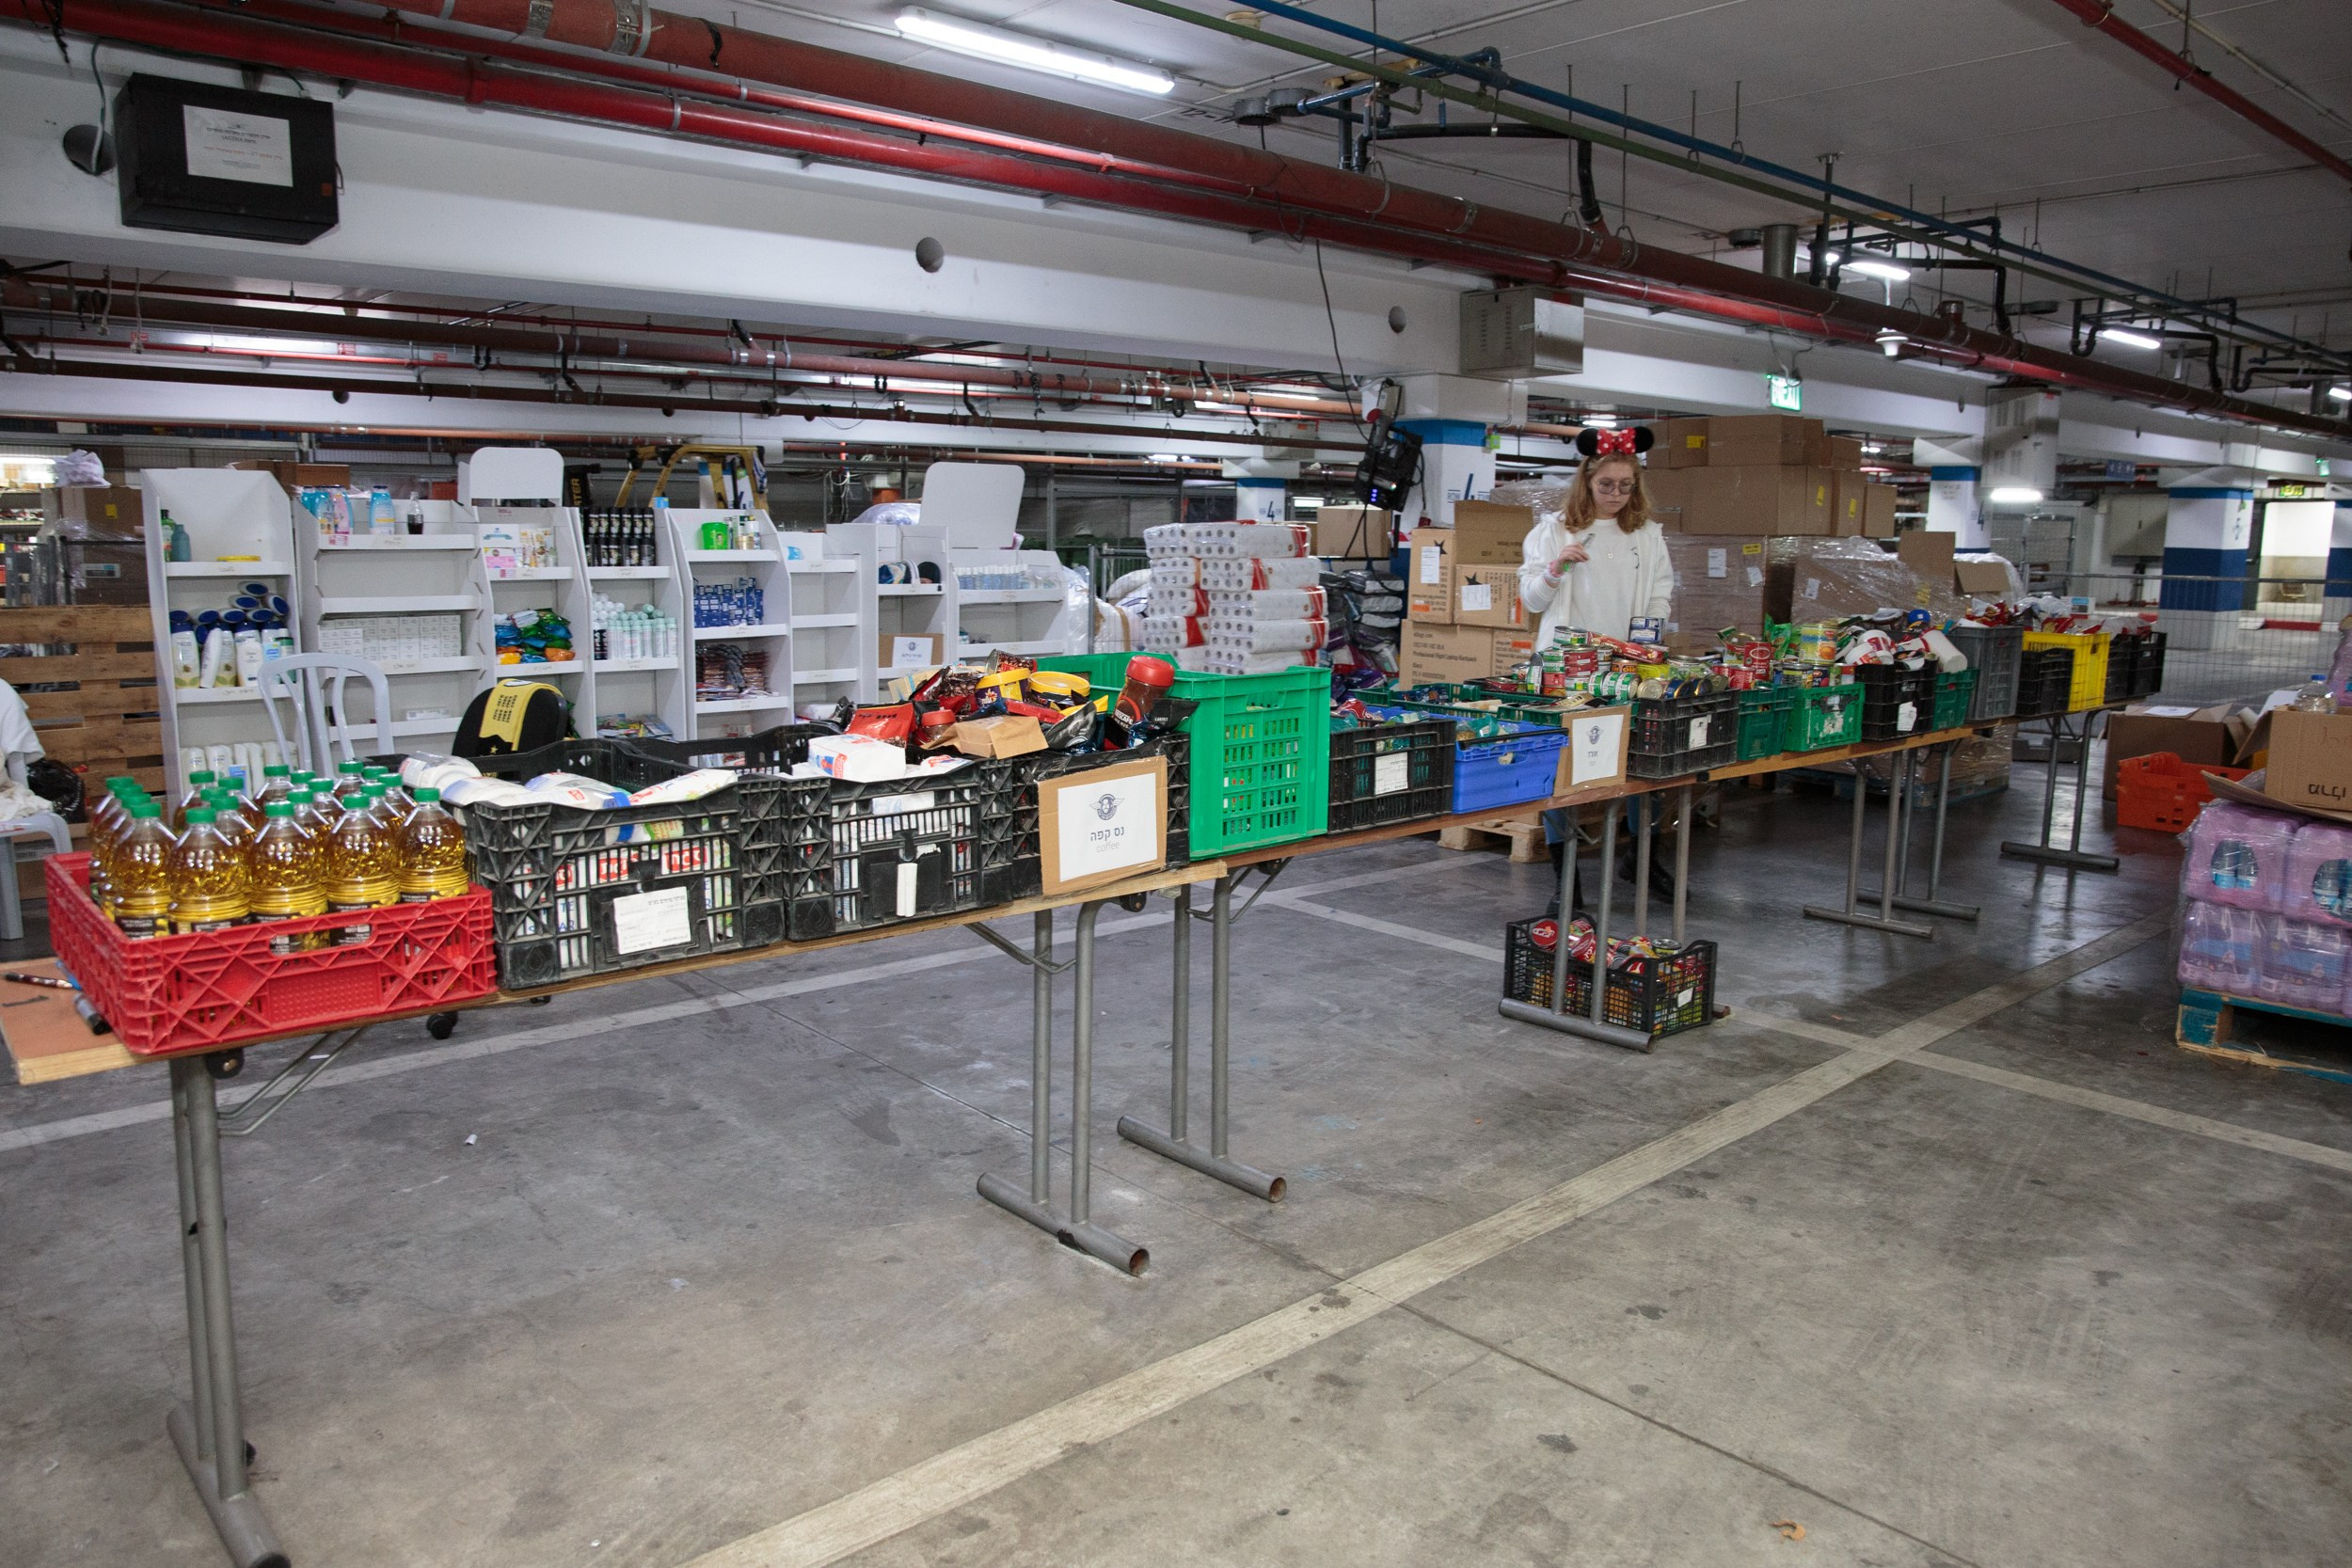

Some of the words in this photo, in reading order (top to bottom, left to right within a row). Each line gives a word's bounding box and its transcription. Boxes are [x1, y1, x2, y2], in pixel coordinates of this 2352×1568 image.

[1090, 830, 1111, 842] קפה
[1114, 826, 1125, 837] נס
[1096, 840, 1120, 853] coffee
